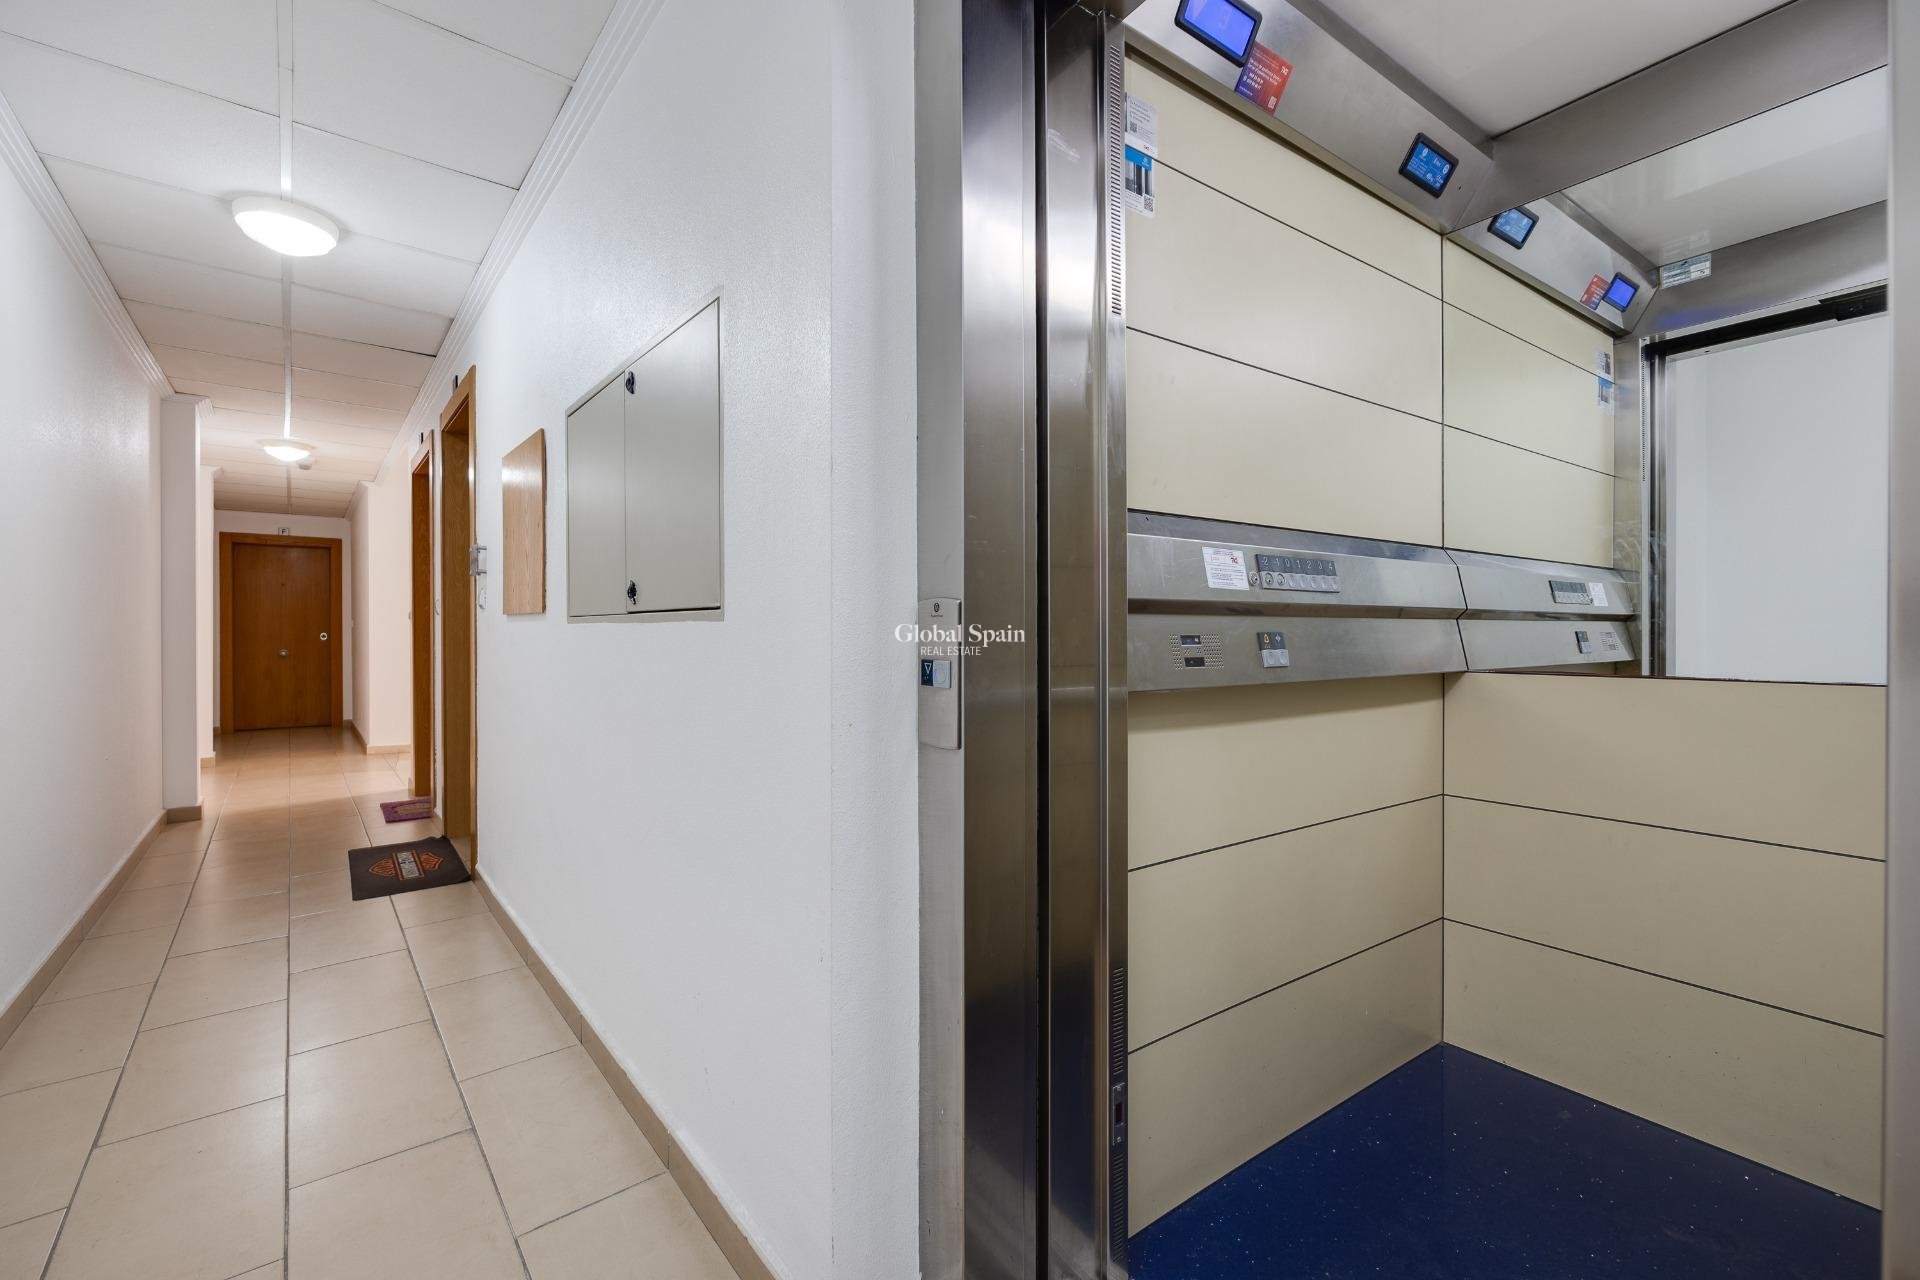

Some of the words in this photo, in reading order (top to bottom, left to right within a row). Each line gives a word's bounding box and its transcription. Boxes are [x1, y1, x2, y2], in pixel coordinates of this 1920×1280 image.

[1284, 558, 1290, 567] 0
[1306, 560, 1312, 569] 2
[1318, 562, 1322, 570] 3
[1328, 562, 1334, 571] 4
